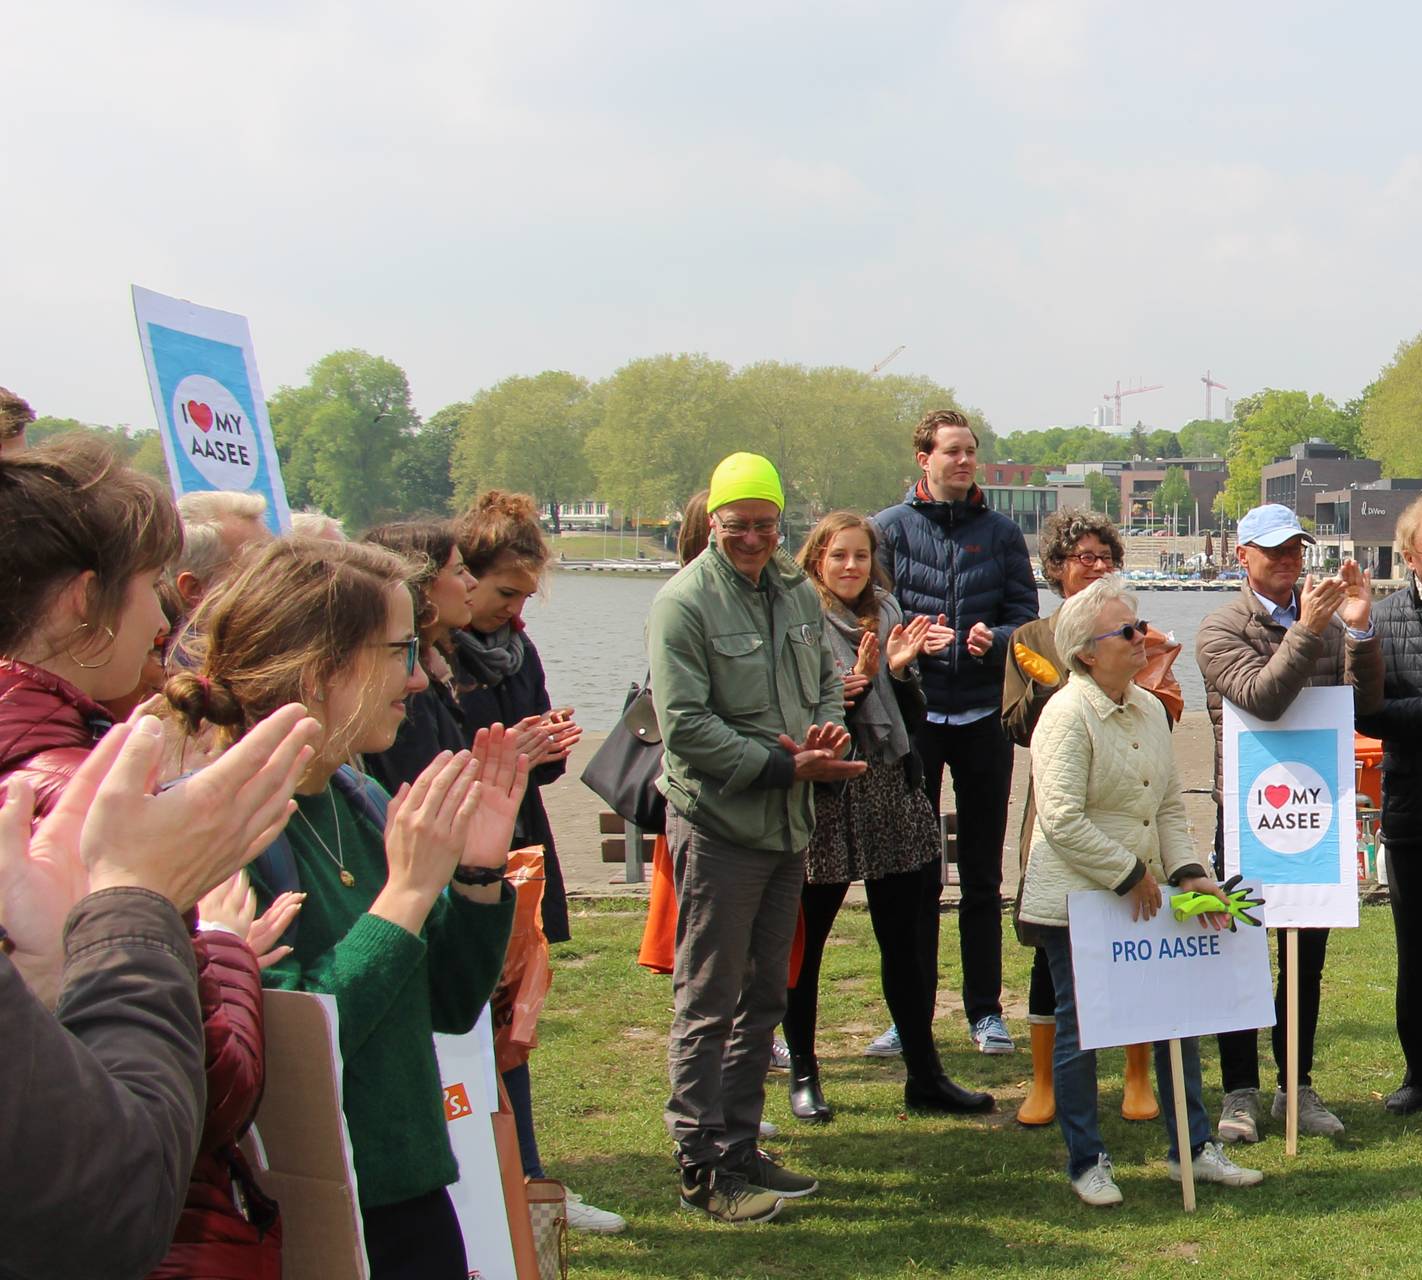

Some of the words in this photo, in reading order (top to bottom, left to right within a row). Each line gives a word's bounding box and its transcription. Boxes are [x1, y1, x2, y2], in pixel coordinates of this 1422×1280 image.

[181, 403, 189, 424] I
[215, 411, 242, 435] MY
[191, 436, 250, 466] AASEE
[1257, 789, 1262, 805] I
[1291, 788, 1321, 805] MY
[1257, 813, 1321, 830] AASEE
[1112, 939, 1152, 962] PRO
[1158, 934, 1221, 959] AASEE
